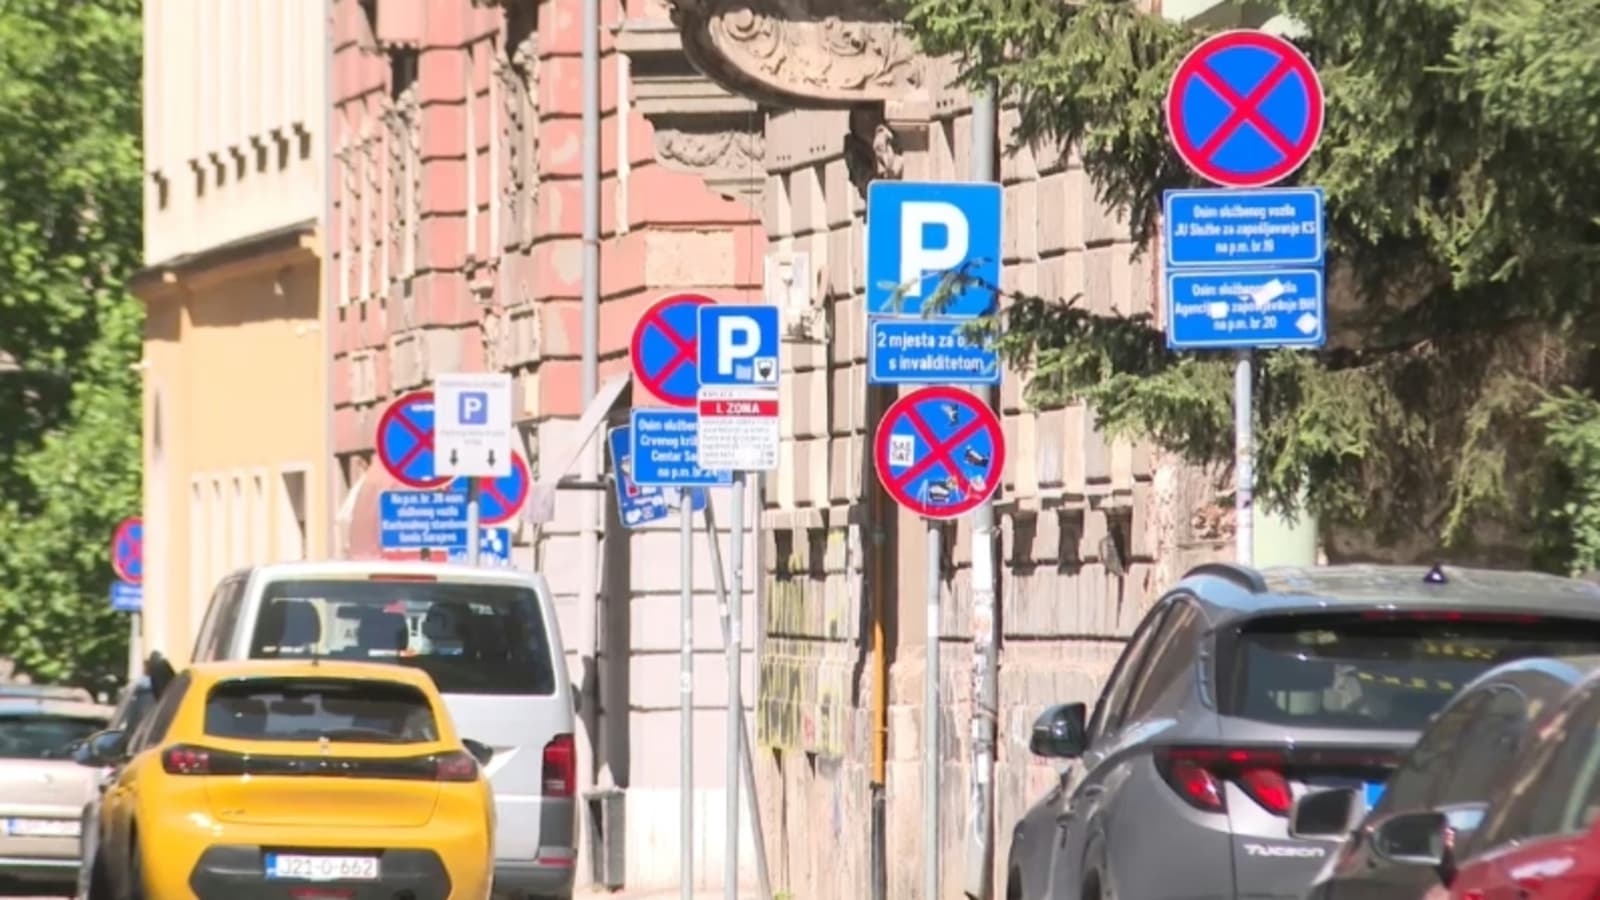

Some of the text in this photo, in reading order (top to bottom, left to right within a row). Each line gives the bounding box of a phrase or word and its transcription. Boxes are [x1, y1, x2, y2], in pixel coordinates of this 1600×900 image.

[1193, 205, 1218, 218] Osim
[901, 201, 969, 297] P
[718, 315, 761, 375] P
[877, 331, 886, 347] 2
[889, 331, 935, 351] mjesta
[938, 334, 954, 348] za
[888, 353, 983, 371] s invaliditetom
[462, 397, 483, 421] P
[726, 401, 760, 415] ZONA
[638, 418, 662, 432] Osim
